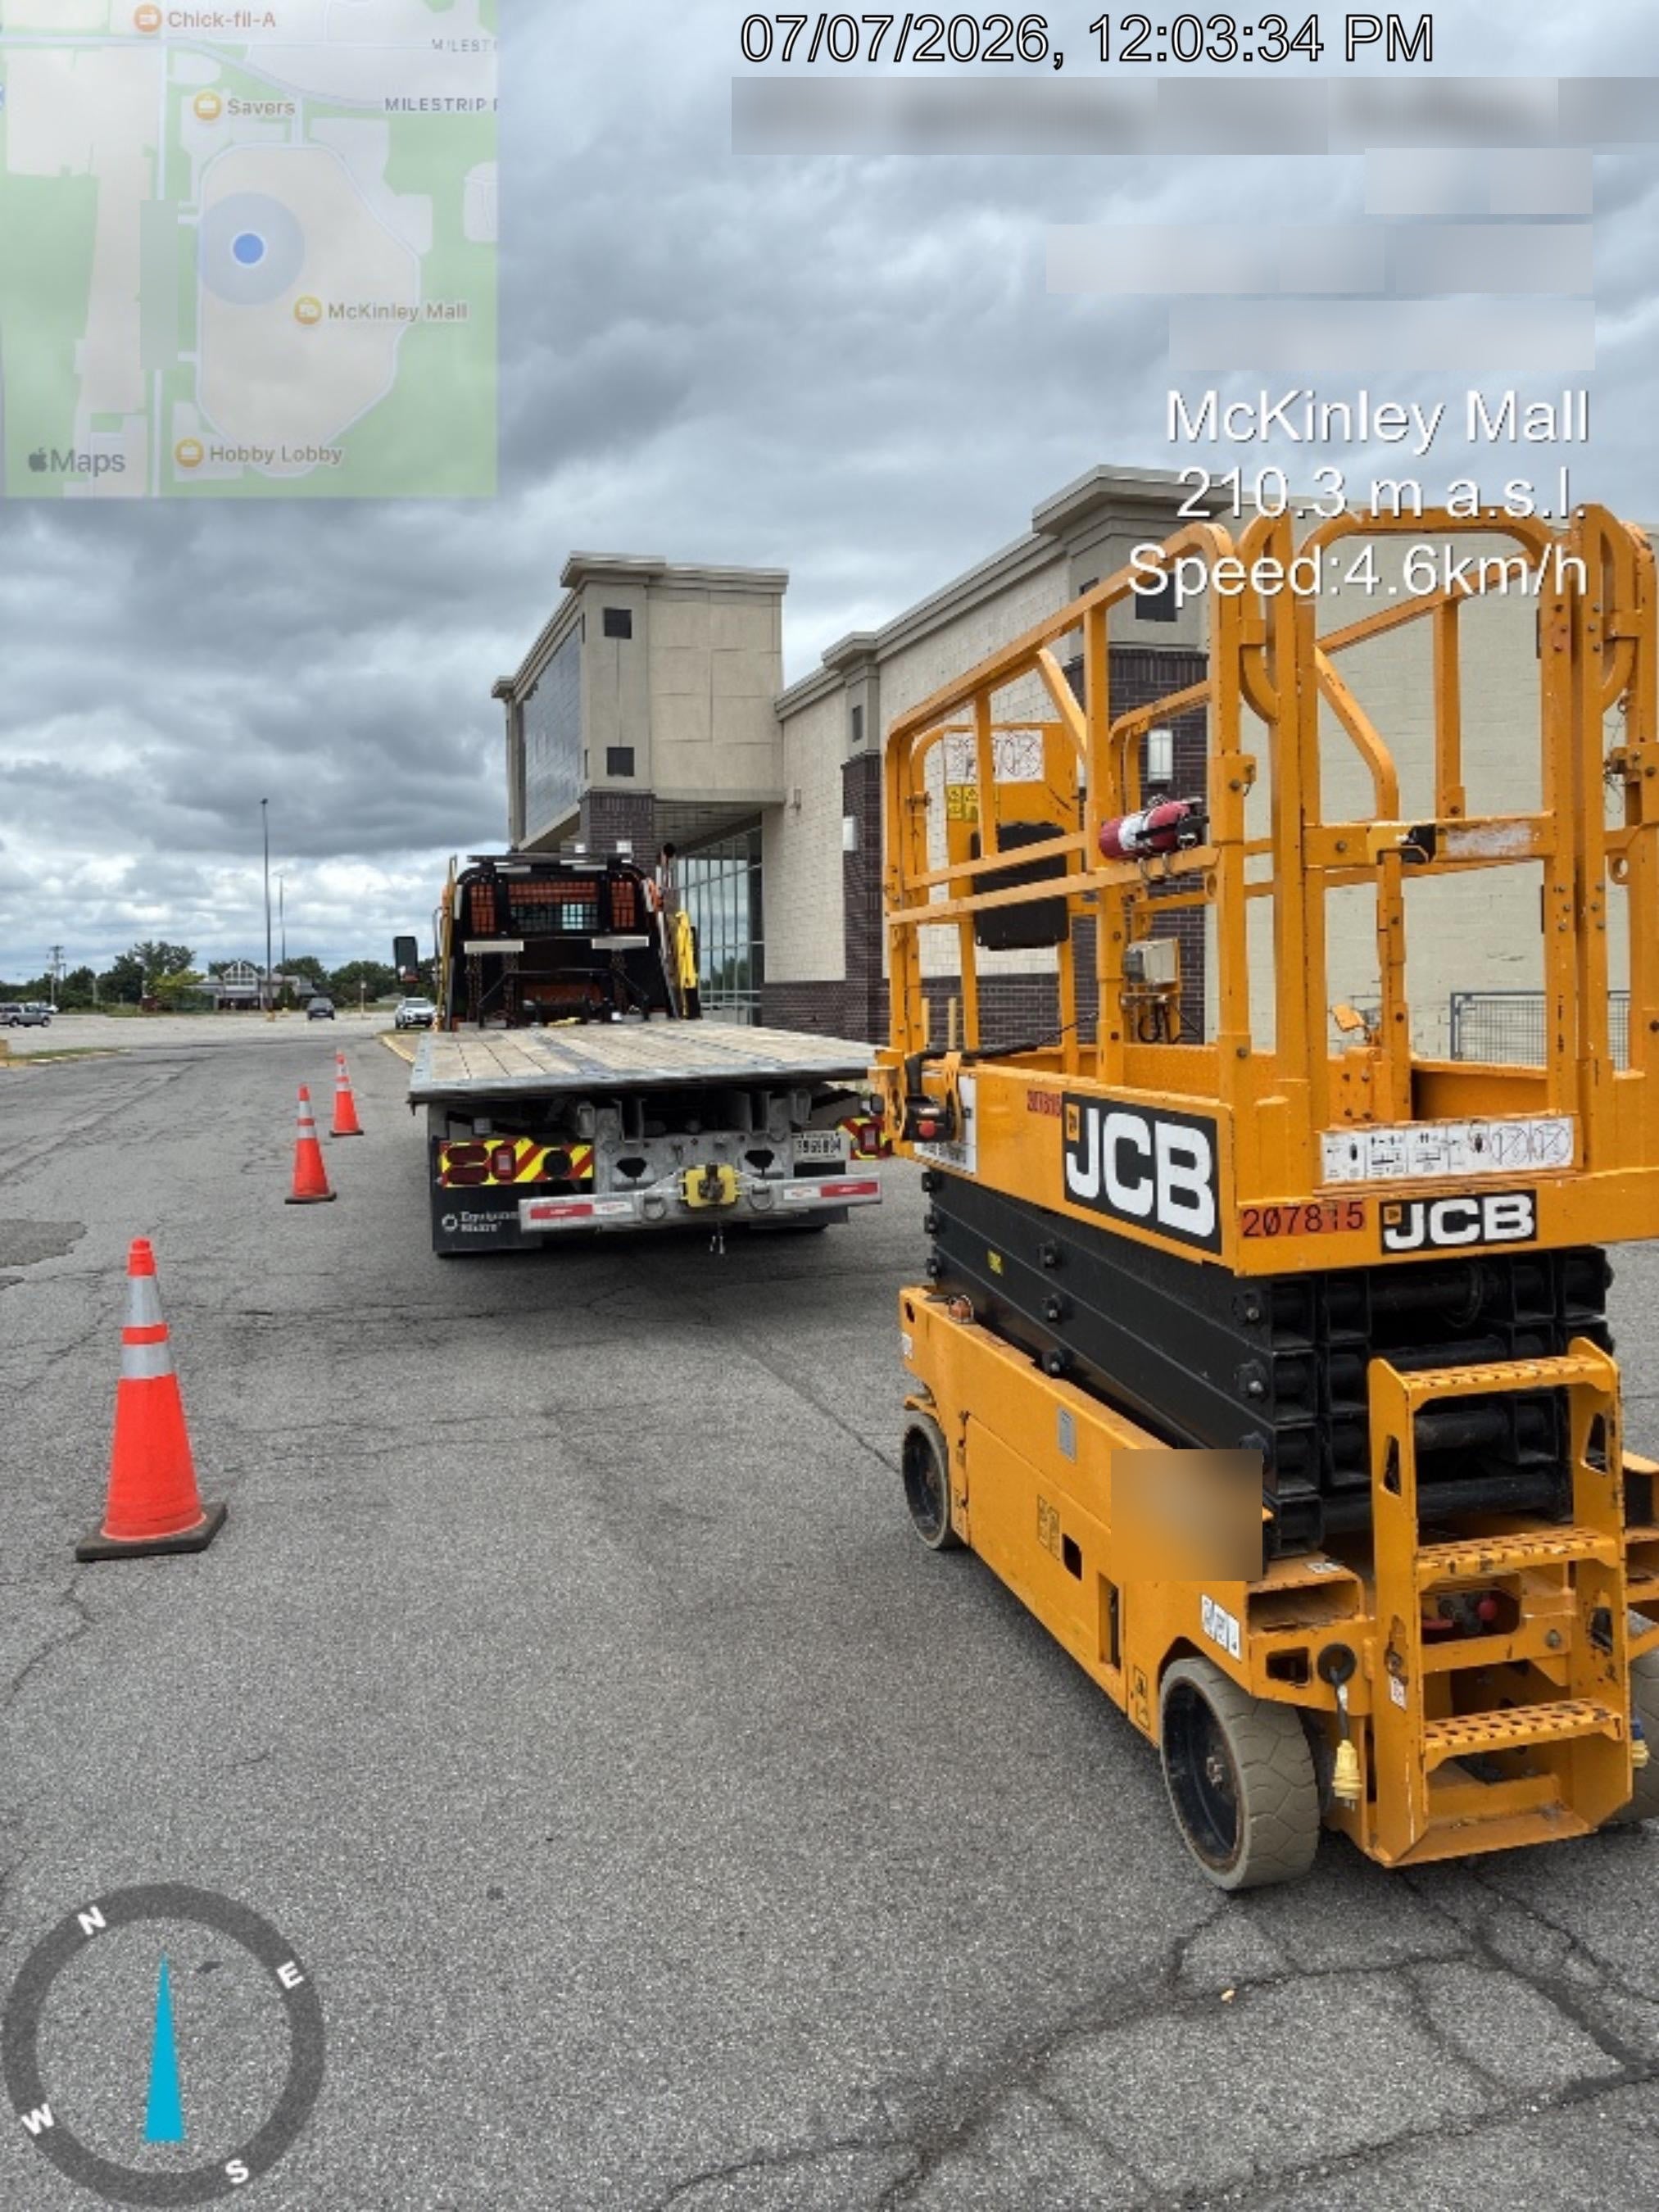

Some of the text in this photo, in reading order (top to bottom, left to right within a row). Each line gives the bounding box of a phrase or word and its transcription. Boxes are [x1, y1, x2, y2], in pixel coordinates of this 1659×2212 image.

[1065, 1106, 1216, 1238] JCB
[1243, 1201, 1365, 1239] 207815
[1383, 1194, 1536, 1250] JCB
